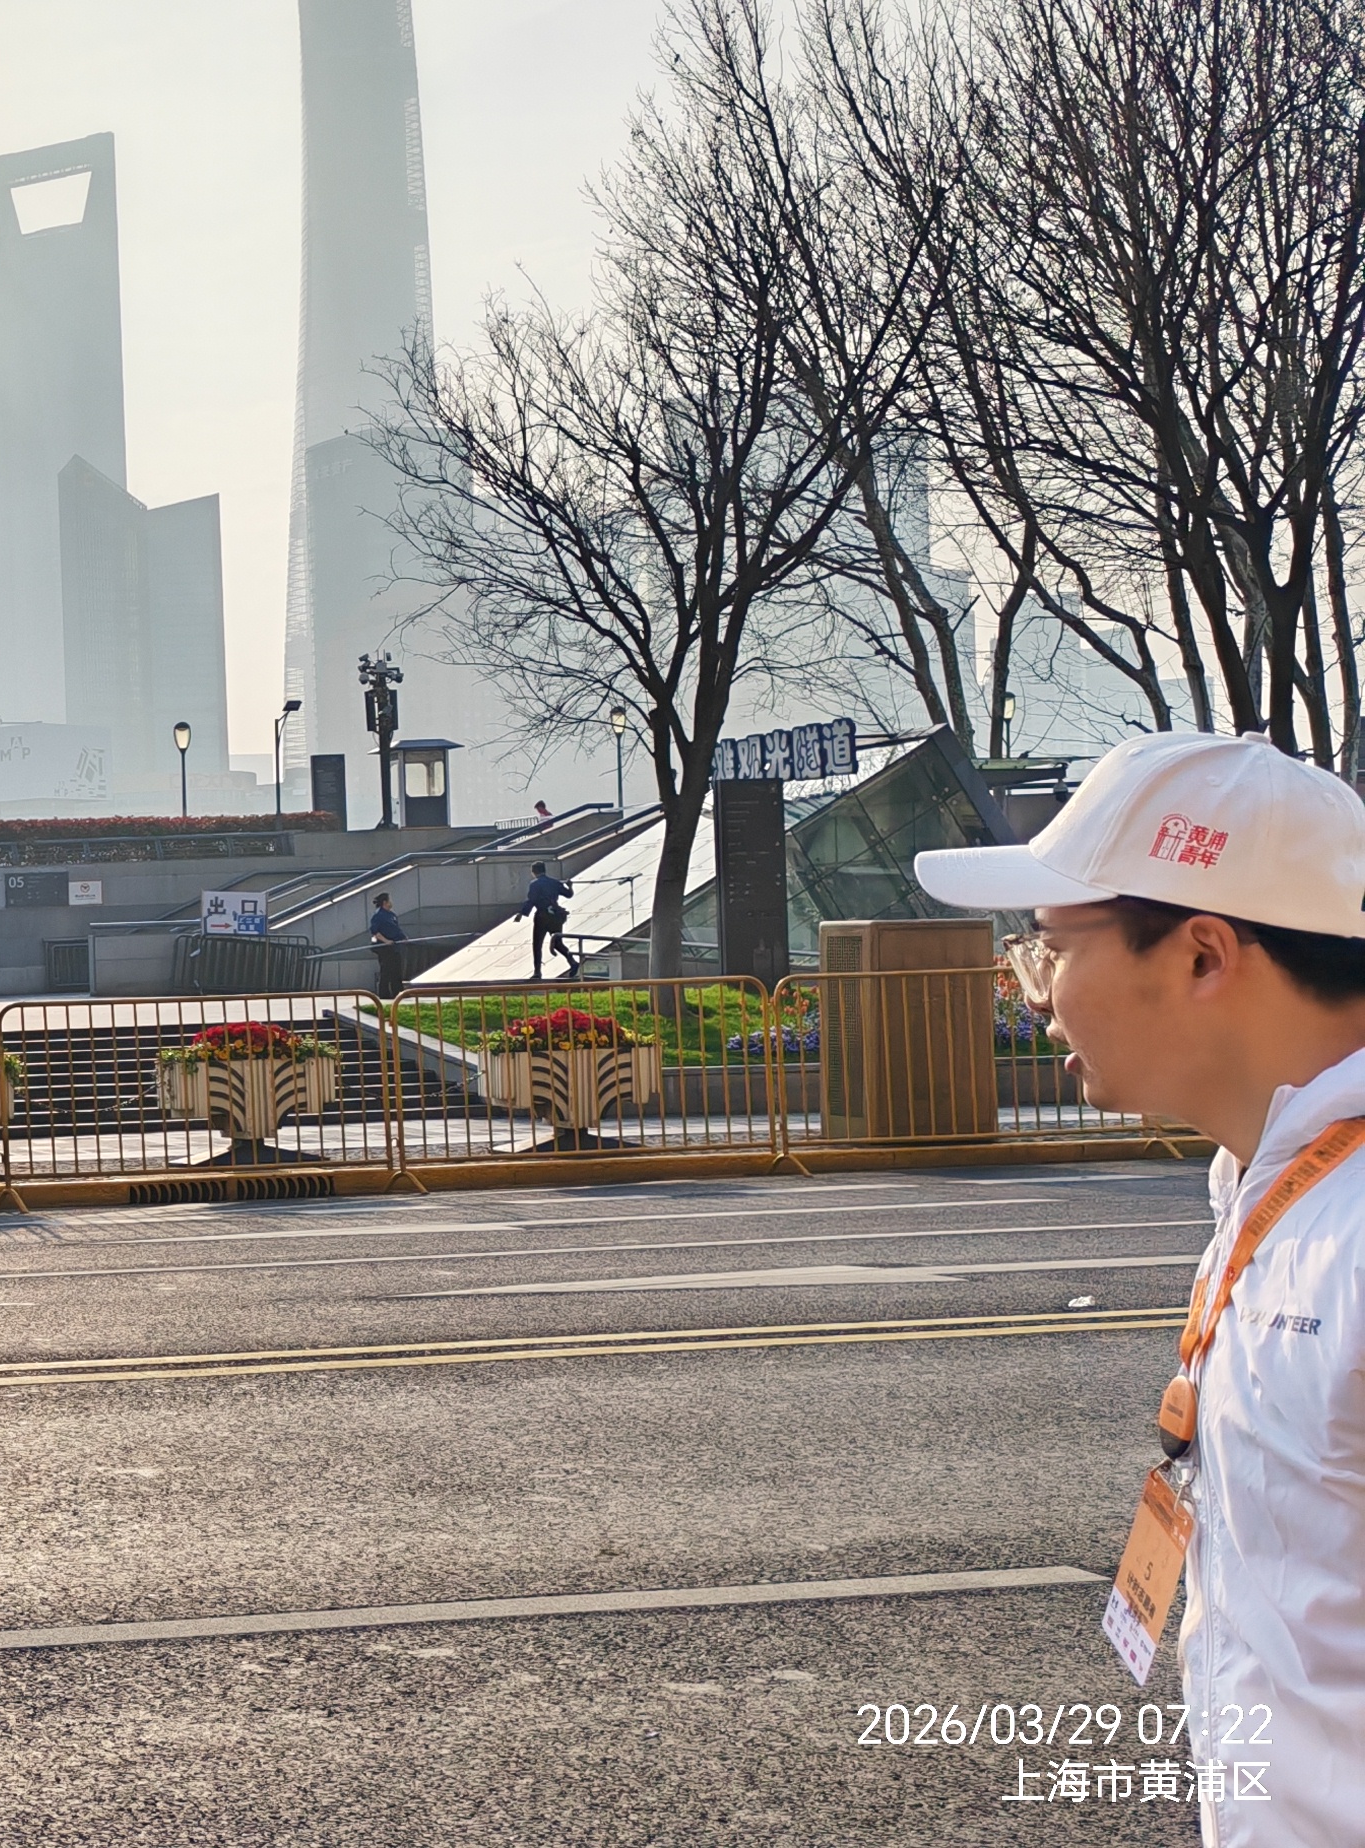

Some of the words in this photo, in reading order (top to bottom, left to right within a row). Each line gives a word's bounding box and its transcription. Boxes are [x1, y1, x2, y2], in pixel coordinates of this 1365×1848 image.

[1186, 825, 1229, 851] 黄浦
[1177, 844, 1221, 869] 青年
[9, 876, 25, 888] 05
[207, 896, 258, 915] 出口
